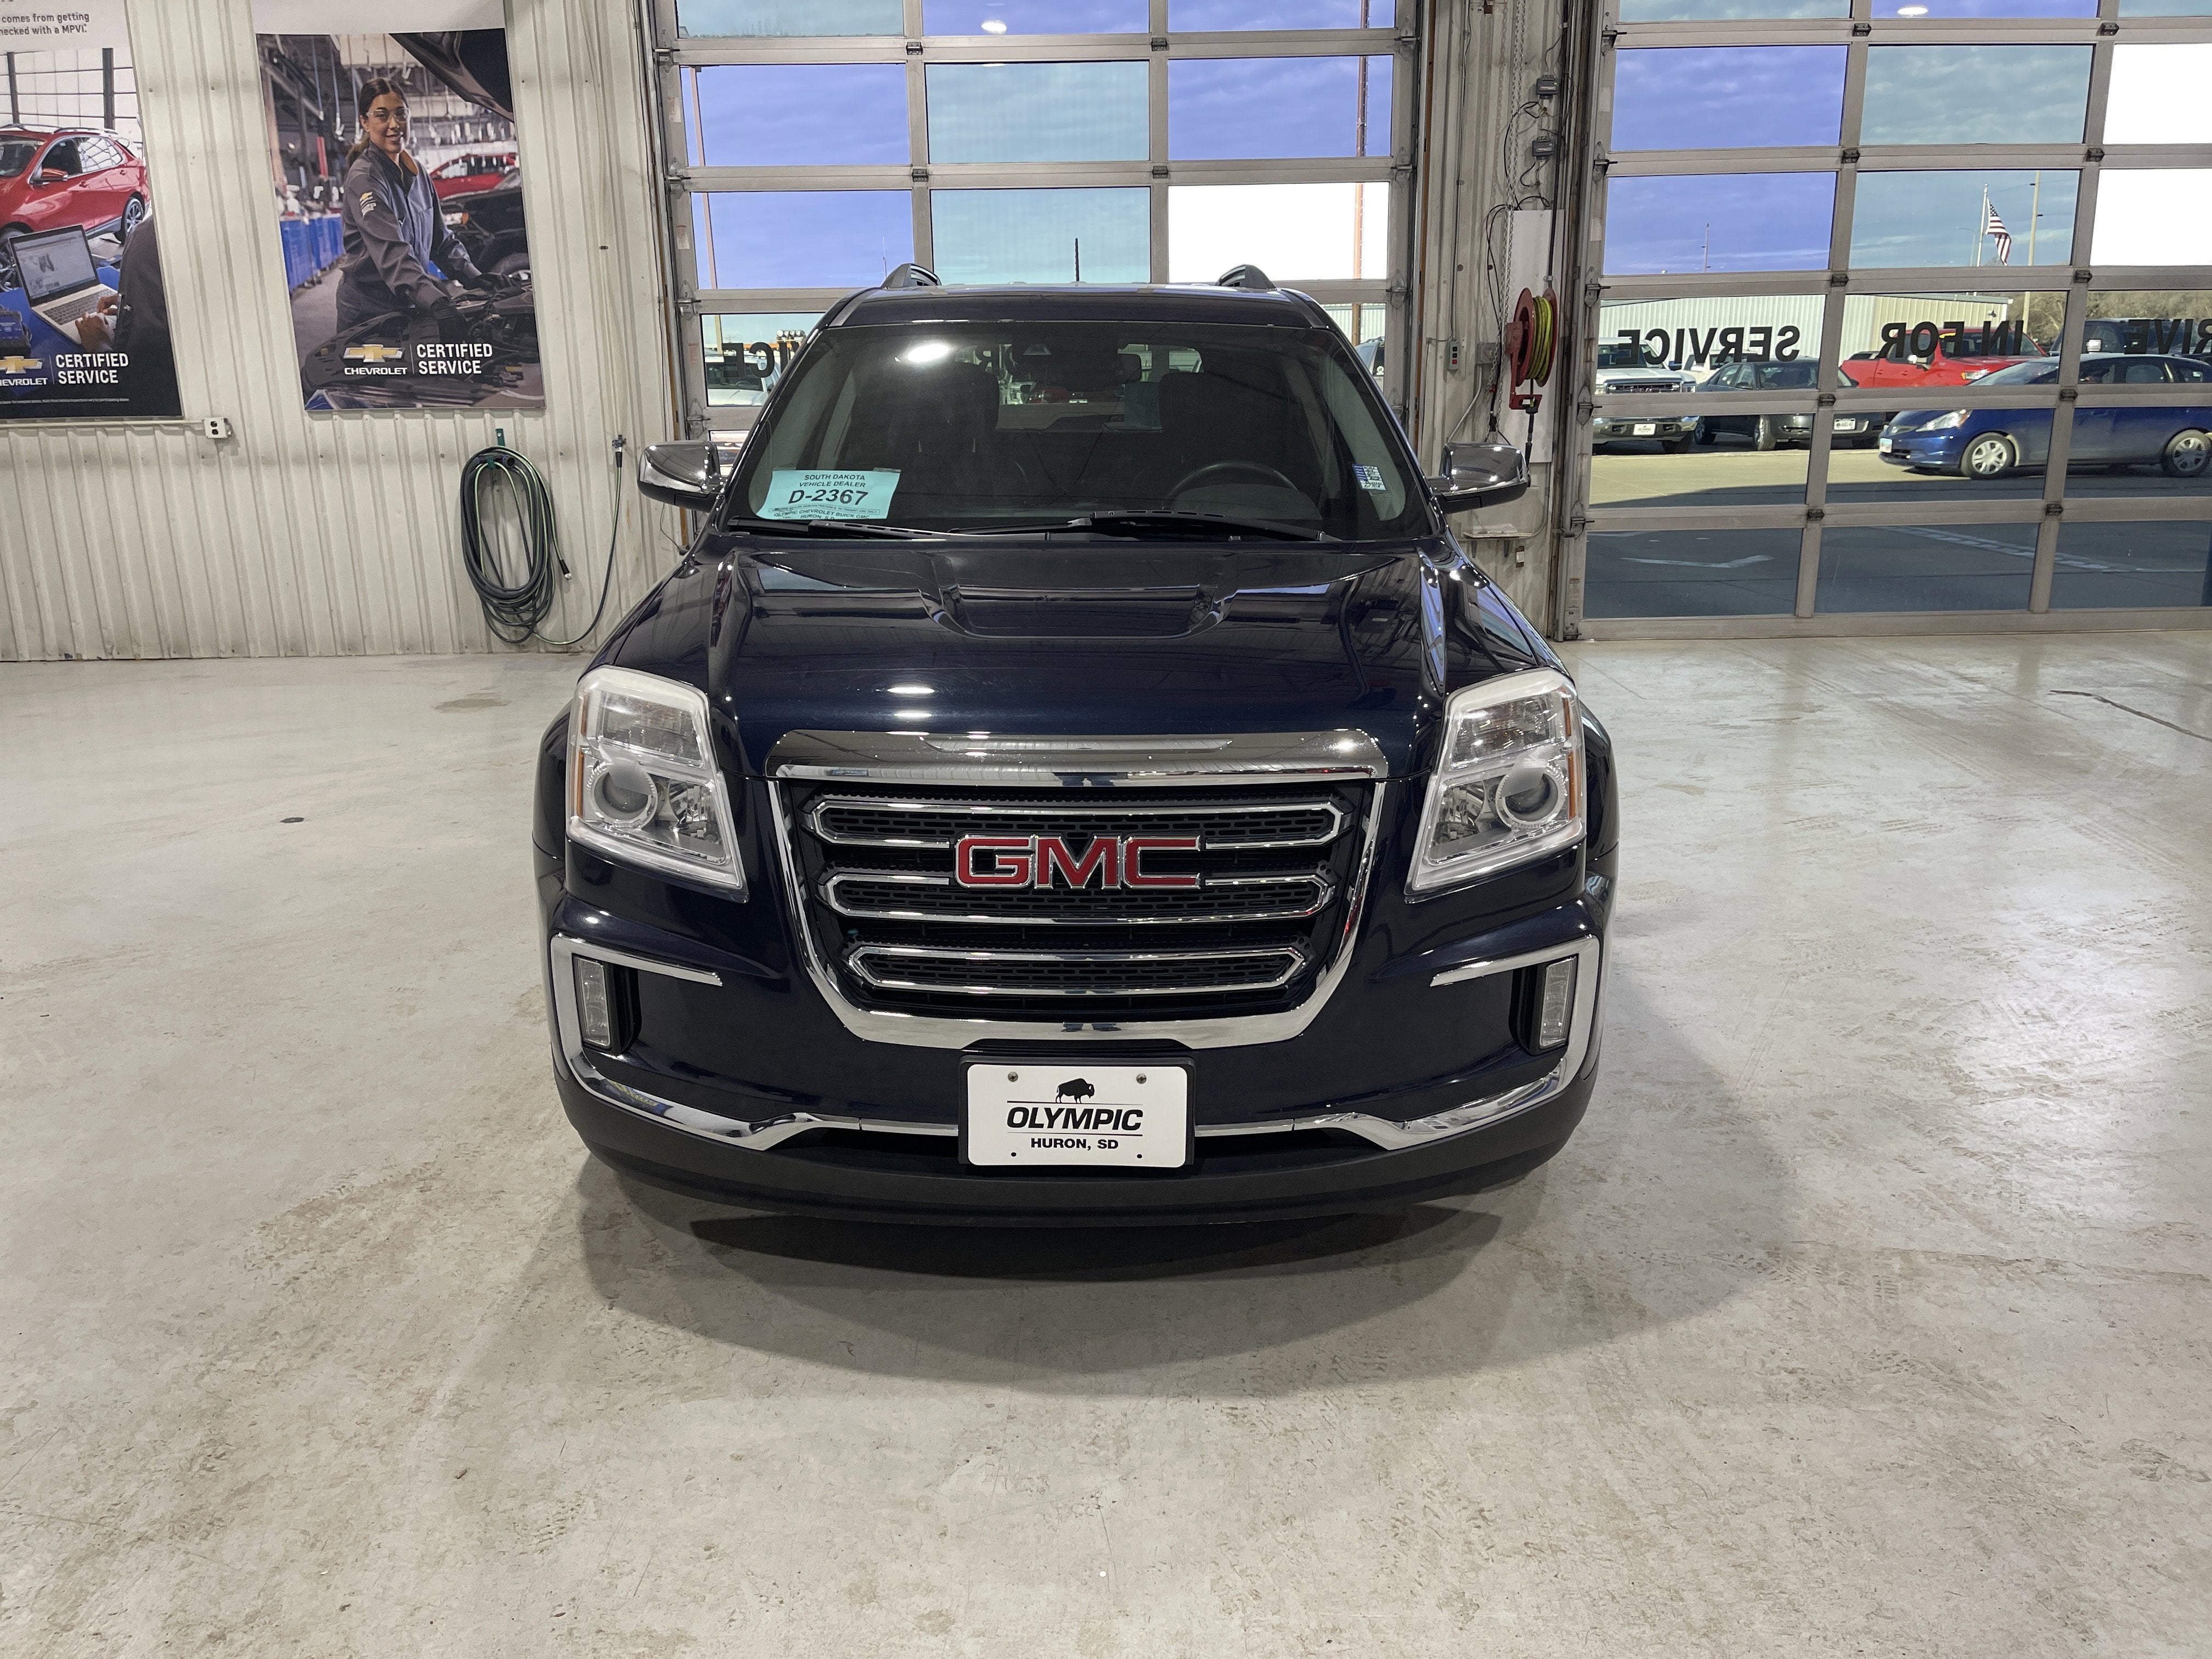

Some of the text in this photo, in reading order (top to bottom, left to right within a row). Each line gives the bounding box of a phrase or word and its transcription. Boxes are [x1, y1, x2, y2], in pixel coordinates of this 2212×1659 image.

[32, 13, 55, 22] from
[57, 12, 90, 24] getting
[32, 26, 52, 35] with
[415, 343, 493, 358] CERTIFIED
[55, 353, 129, 368] CERTIFIED
[418, 360, 482, 375] SERVICE
[58, 369, 119, 384] SERVICE
[344, 367, 408, 375] CHEVROLET
[788, 489, 868, 505] D-2367
[955, 834, 1201, 889] GMC
[1007, 1107, 1143, 1131] OLYMPIC
[1031, 1138, 1119, 1150] HURON, SD
